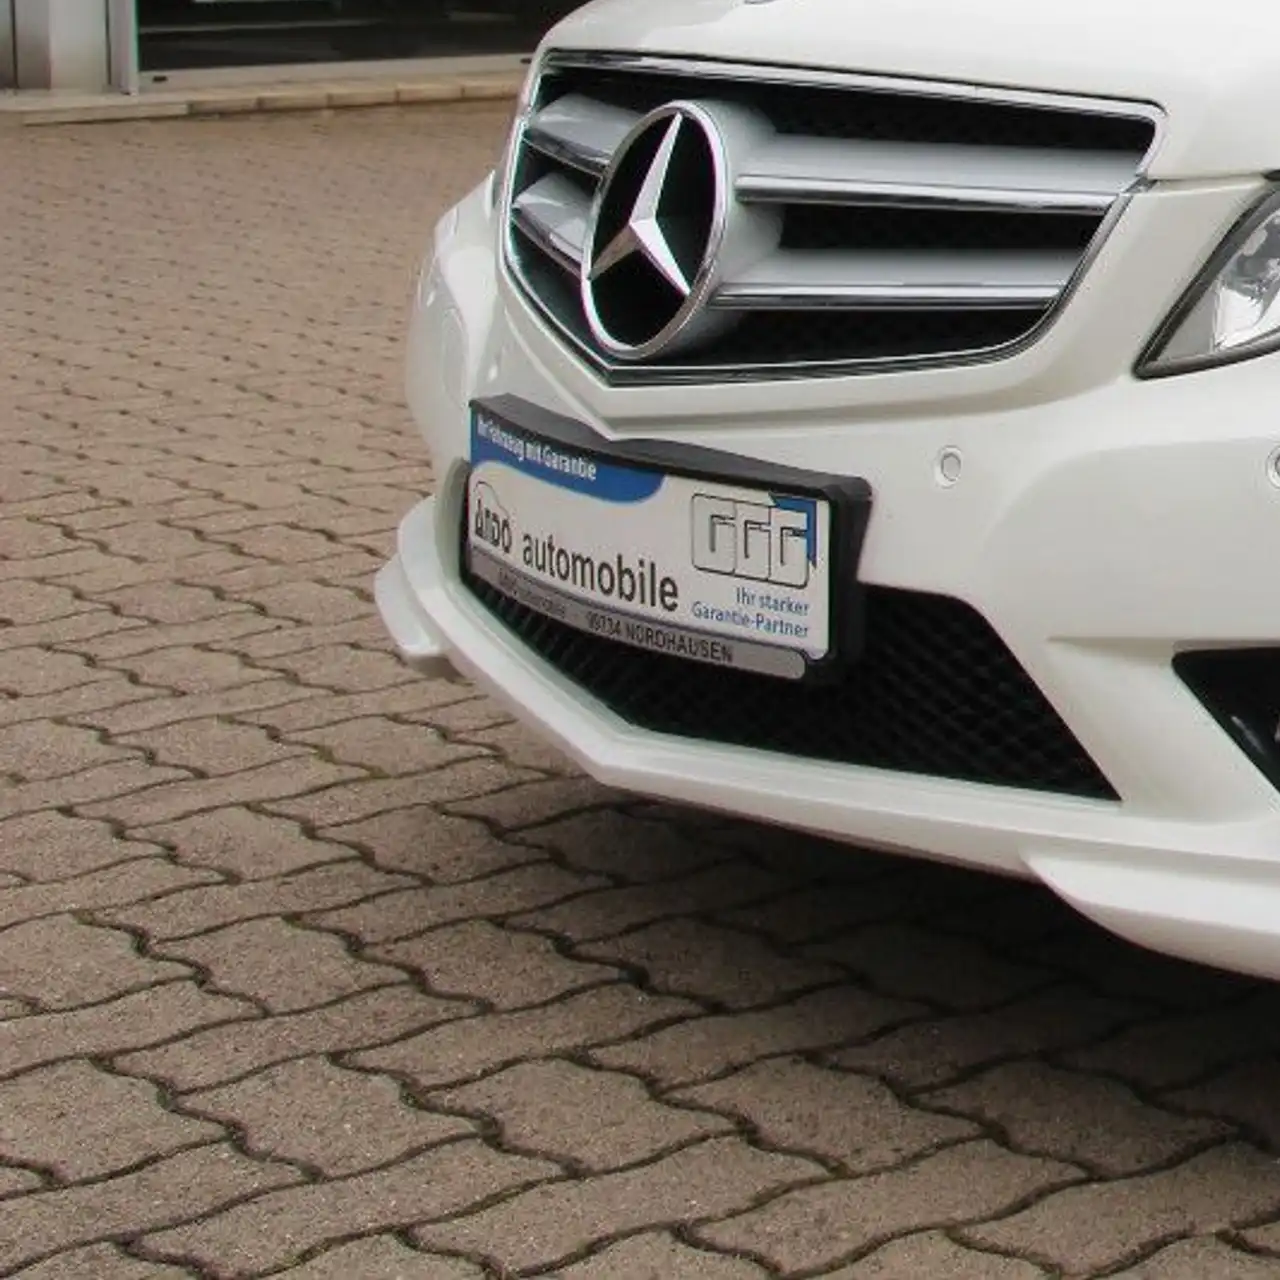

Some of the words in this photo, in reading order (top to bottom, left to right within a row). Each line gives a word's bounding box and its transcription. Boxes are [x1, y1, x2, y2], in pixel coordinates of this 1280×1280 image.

[542, 445, 597, 482] Garantie
[522, 531, 679, 612] automobile
[691, 600, 809, 638] Garantie-Partner
[736, 587, 756, 606] Ihr
[759, 594, 809, 617] starker
[626, 622, 734, 663] NORDHAUSEN
